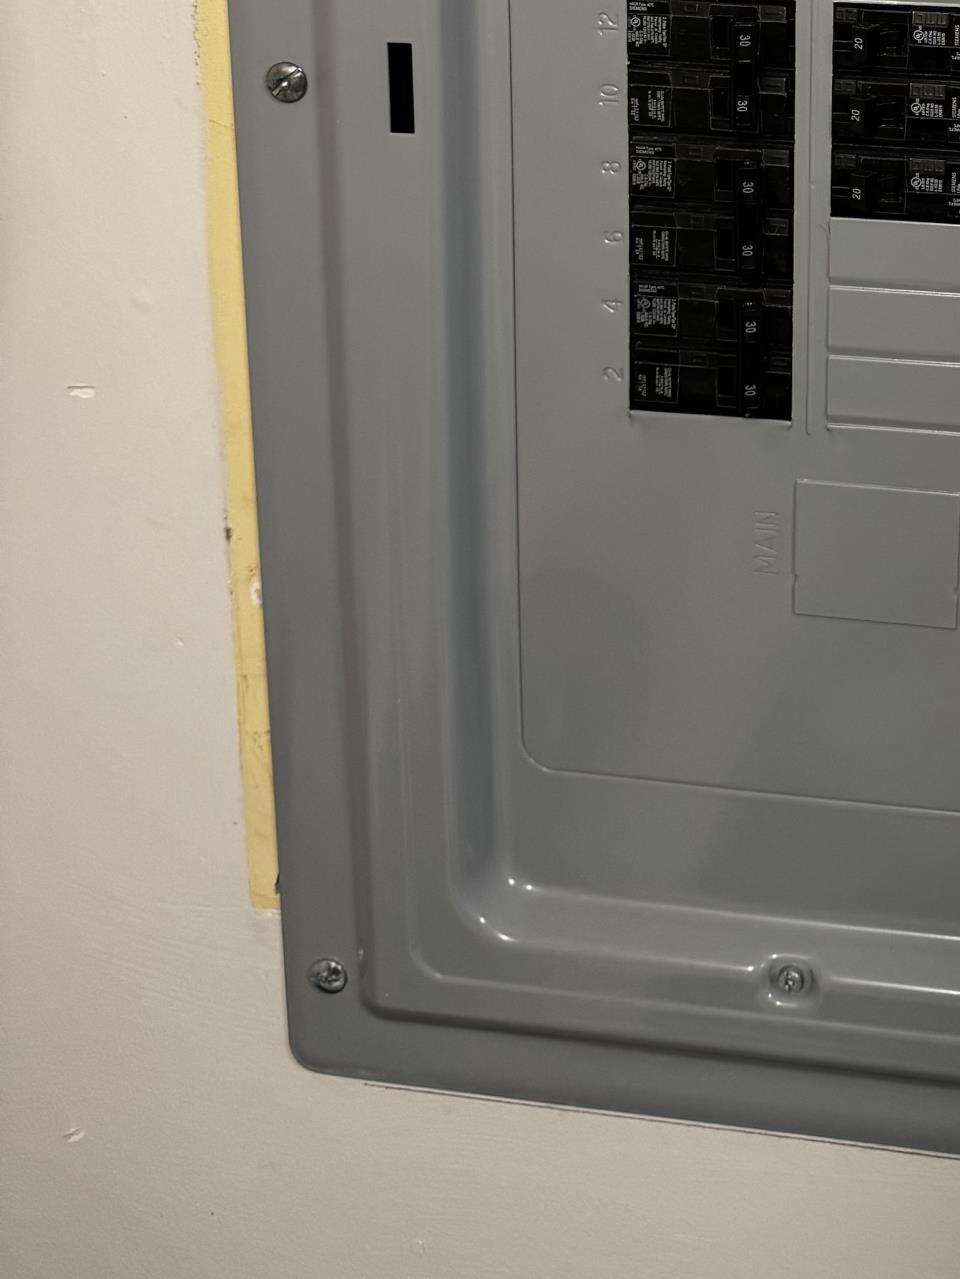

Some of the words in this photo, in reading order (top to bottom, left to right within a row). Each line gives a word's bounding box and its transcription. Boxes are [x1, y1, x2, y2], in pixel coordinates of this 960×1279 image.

[597, 12, 619, 36] 12
[739, 34, 751, 47] 30
[854, 37, 863, 50] 20
[598, 84, 619, 107] 10
[736, 100, 748, 113] 30
[851, 109, 861, 122] 20
[601, 161, 621, 175] 8
[742, 181, 754, 194] 30
[852, 188, 862, 200] 20
[604, 231, 624, 244] 6
[742, 244, 753, 257] 30
[602, 299, 623, 313] 4
[745, 321, 757, 334] 30
[603, 366, 623, 382] 2
[744, 384, 757, 397] 30
[753, 510, 779, 575] MAIN
